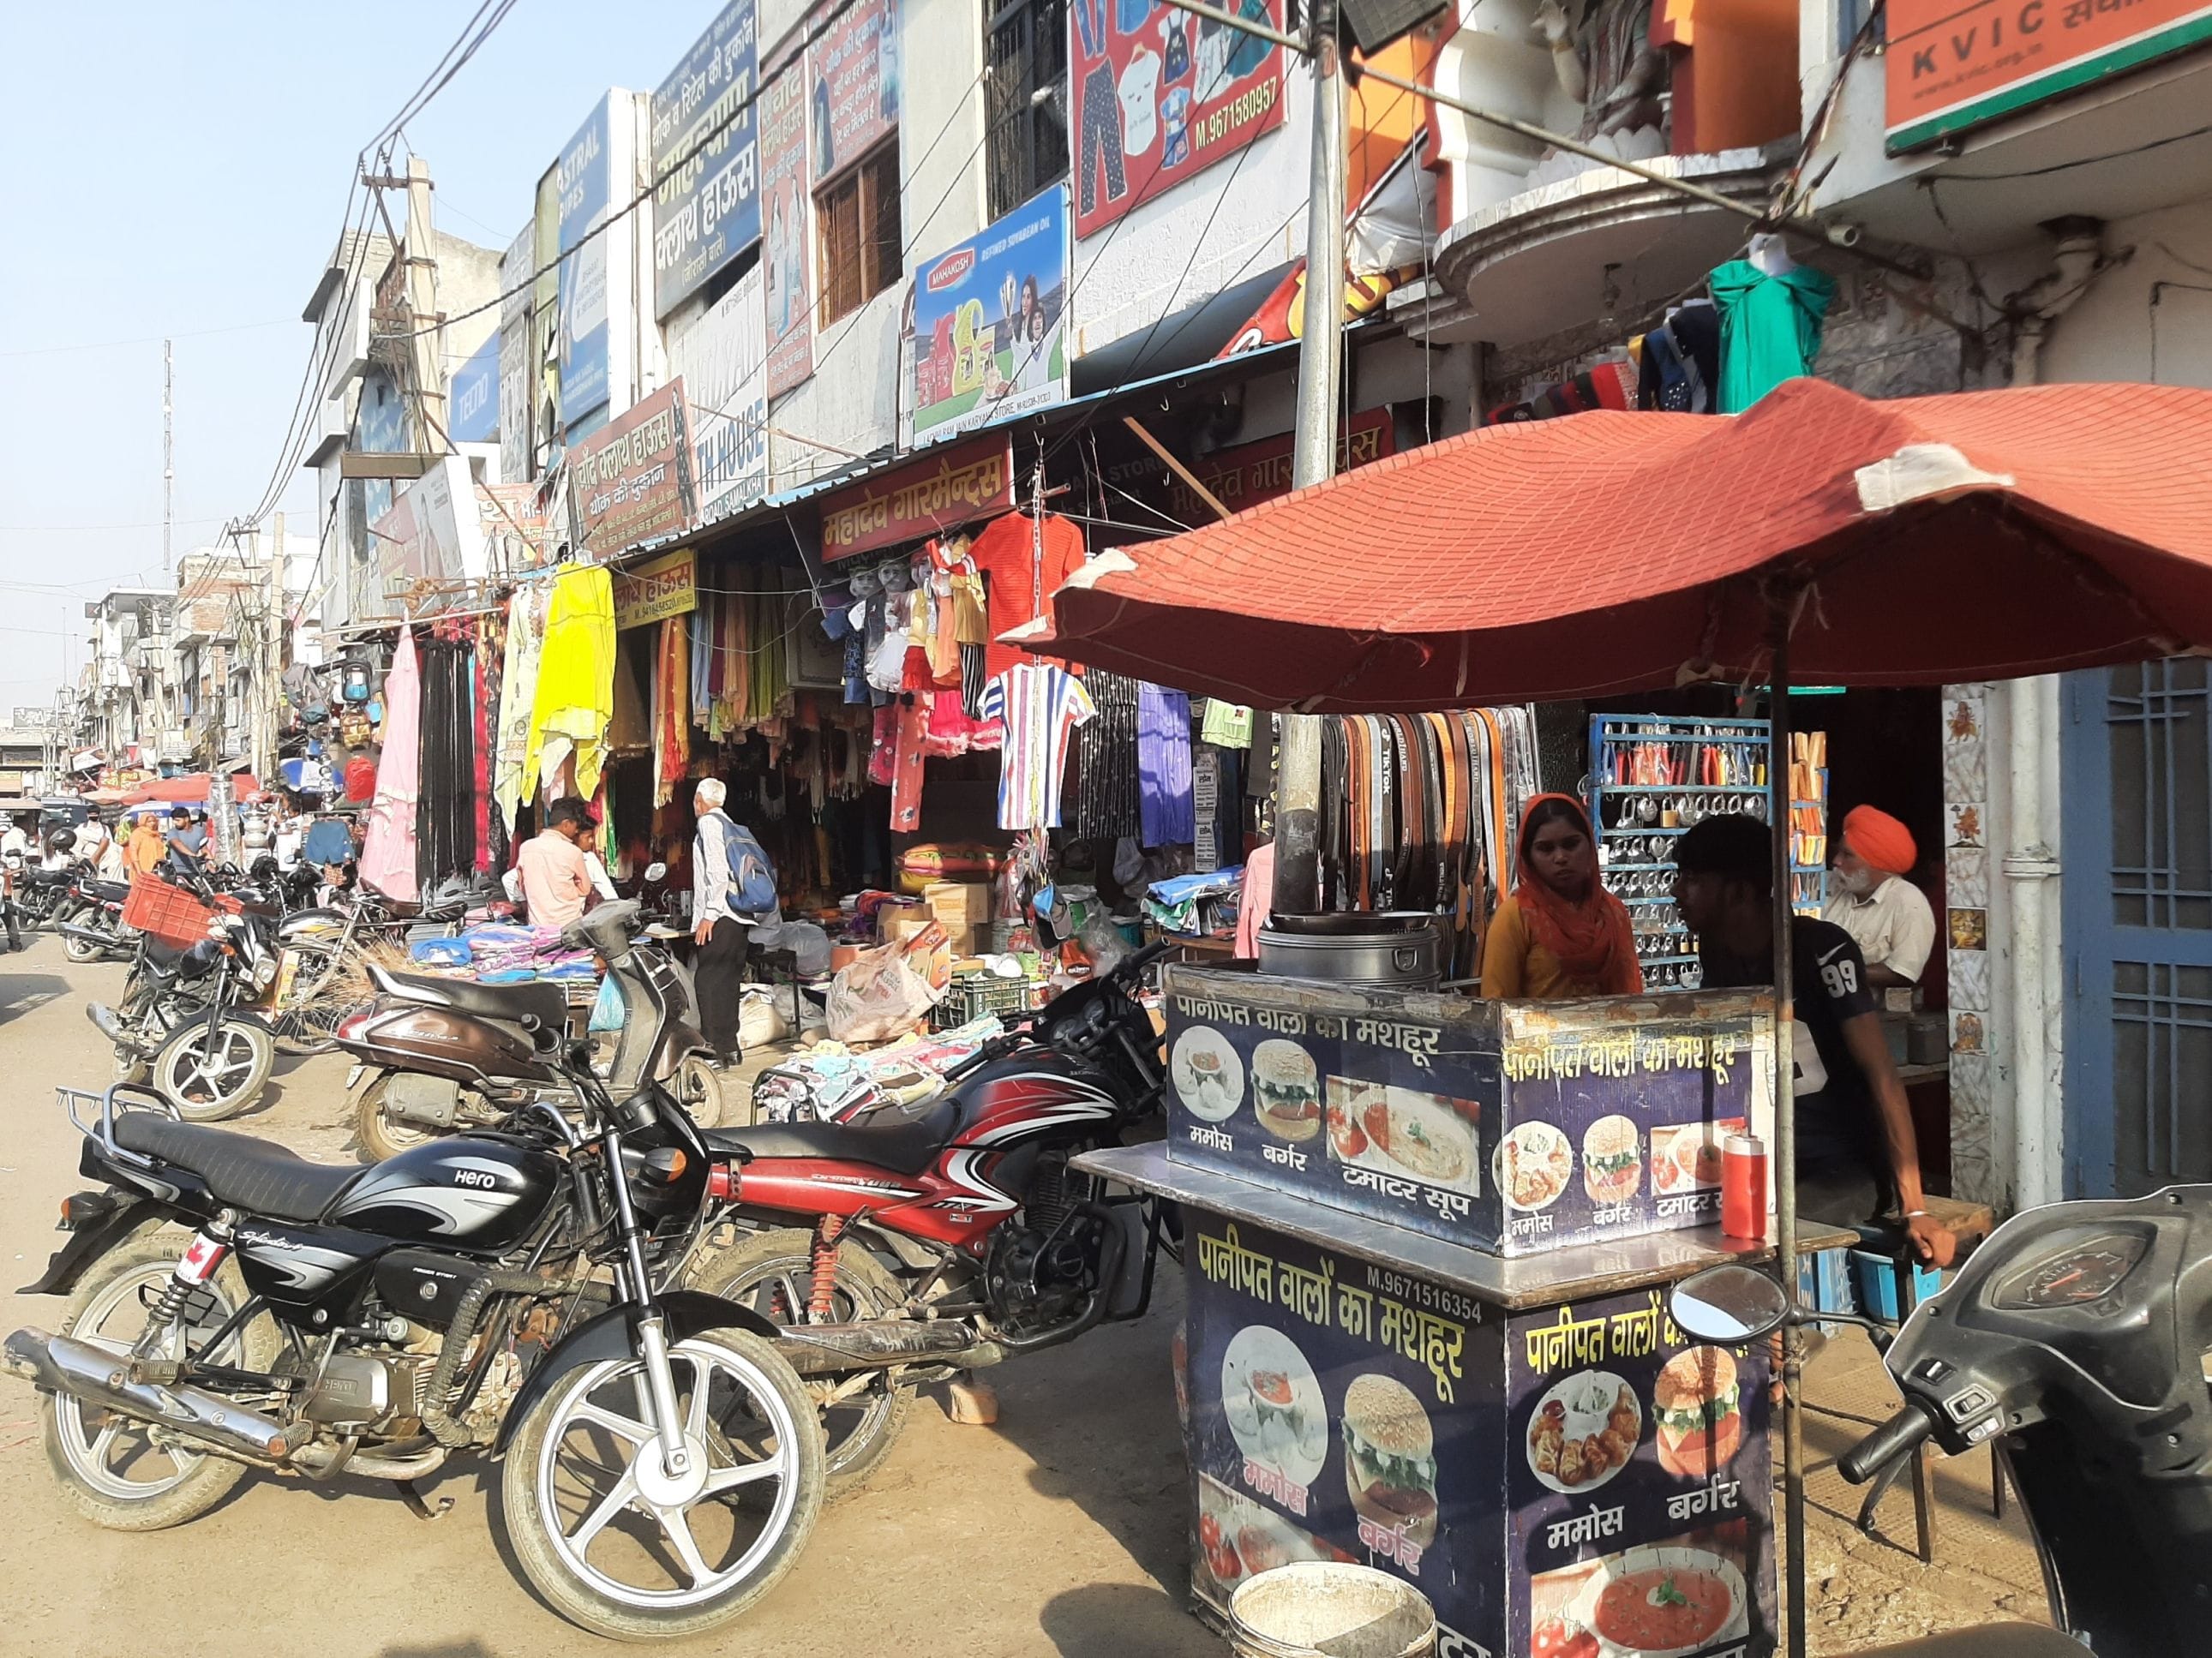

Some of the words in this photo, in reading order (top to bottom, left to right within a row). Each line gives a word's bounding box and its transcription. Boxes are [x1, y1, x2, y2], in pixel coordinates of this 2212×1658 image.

[673, 102, 680, 125] व
[681, 71, 705, 118] रिटेल
[708, 45, 722, 85] की
[1196, 76, 1277, 151] M.9671580957
[557, 117, 599, 193] ASTRAL
[559, 179, 584, 225] PIPES
[702, 140, 756, 236] हाऊस
[932, 255, 969, 284] MAHAKOSH
[631, 405, 672, 467] हाऊस
[718, 398, 764, 484] HOUSE
[588, 485, 611, 518] थोक
[612, 476, 629, 506] की
[824, 488, 889, 545] महादेव
[646, 561, 692, 603] हाऊस
[1820, 959, 1857, 998] 99
[1315, 1013, 1348, 1041] का
[1356, 1016, 1442, 1068] मशहूर
[1642, 1036, 1669, 1073] का
[1189, 1124, 1233, 1152] ममोस
[1262, 1142, 1308, 1172] बर्गर
[1424, 1188, 1471, 1218] सूप
[1511, 1211, 1553, 1237] ममोस
[1592, 1203, 1632, 1226] बर्गर
[1197, 1223, 1273, 1303] पानीपत
[1279, 1256, 1334, 1327] वालों
[1338, 1281, 1373, 1343] का
[1380, 1296, 1465, 1404] मशहूर
[1367, 1265, 1483, 1323] M.9671516354
[1526, 1302, 1606, 1374] पानीपत
[1611, 1290, 1662, 1357] वालों
[1244, 1455, 1309, 1517] ममोस
[1667, 1472, 1741, 1521] बर्गर
[1358, 1514, 1424, 1576] बर्गर
[1547, 1502, 1625, 1549] ममोस
